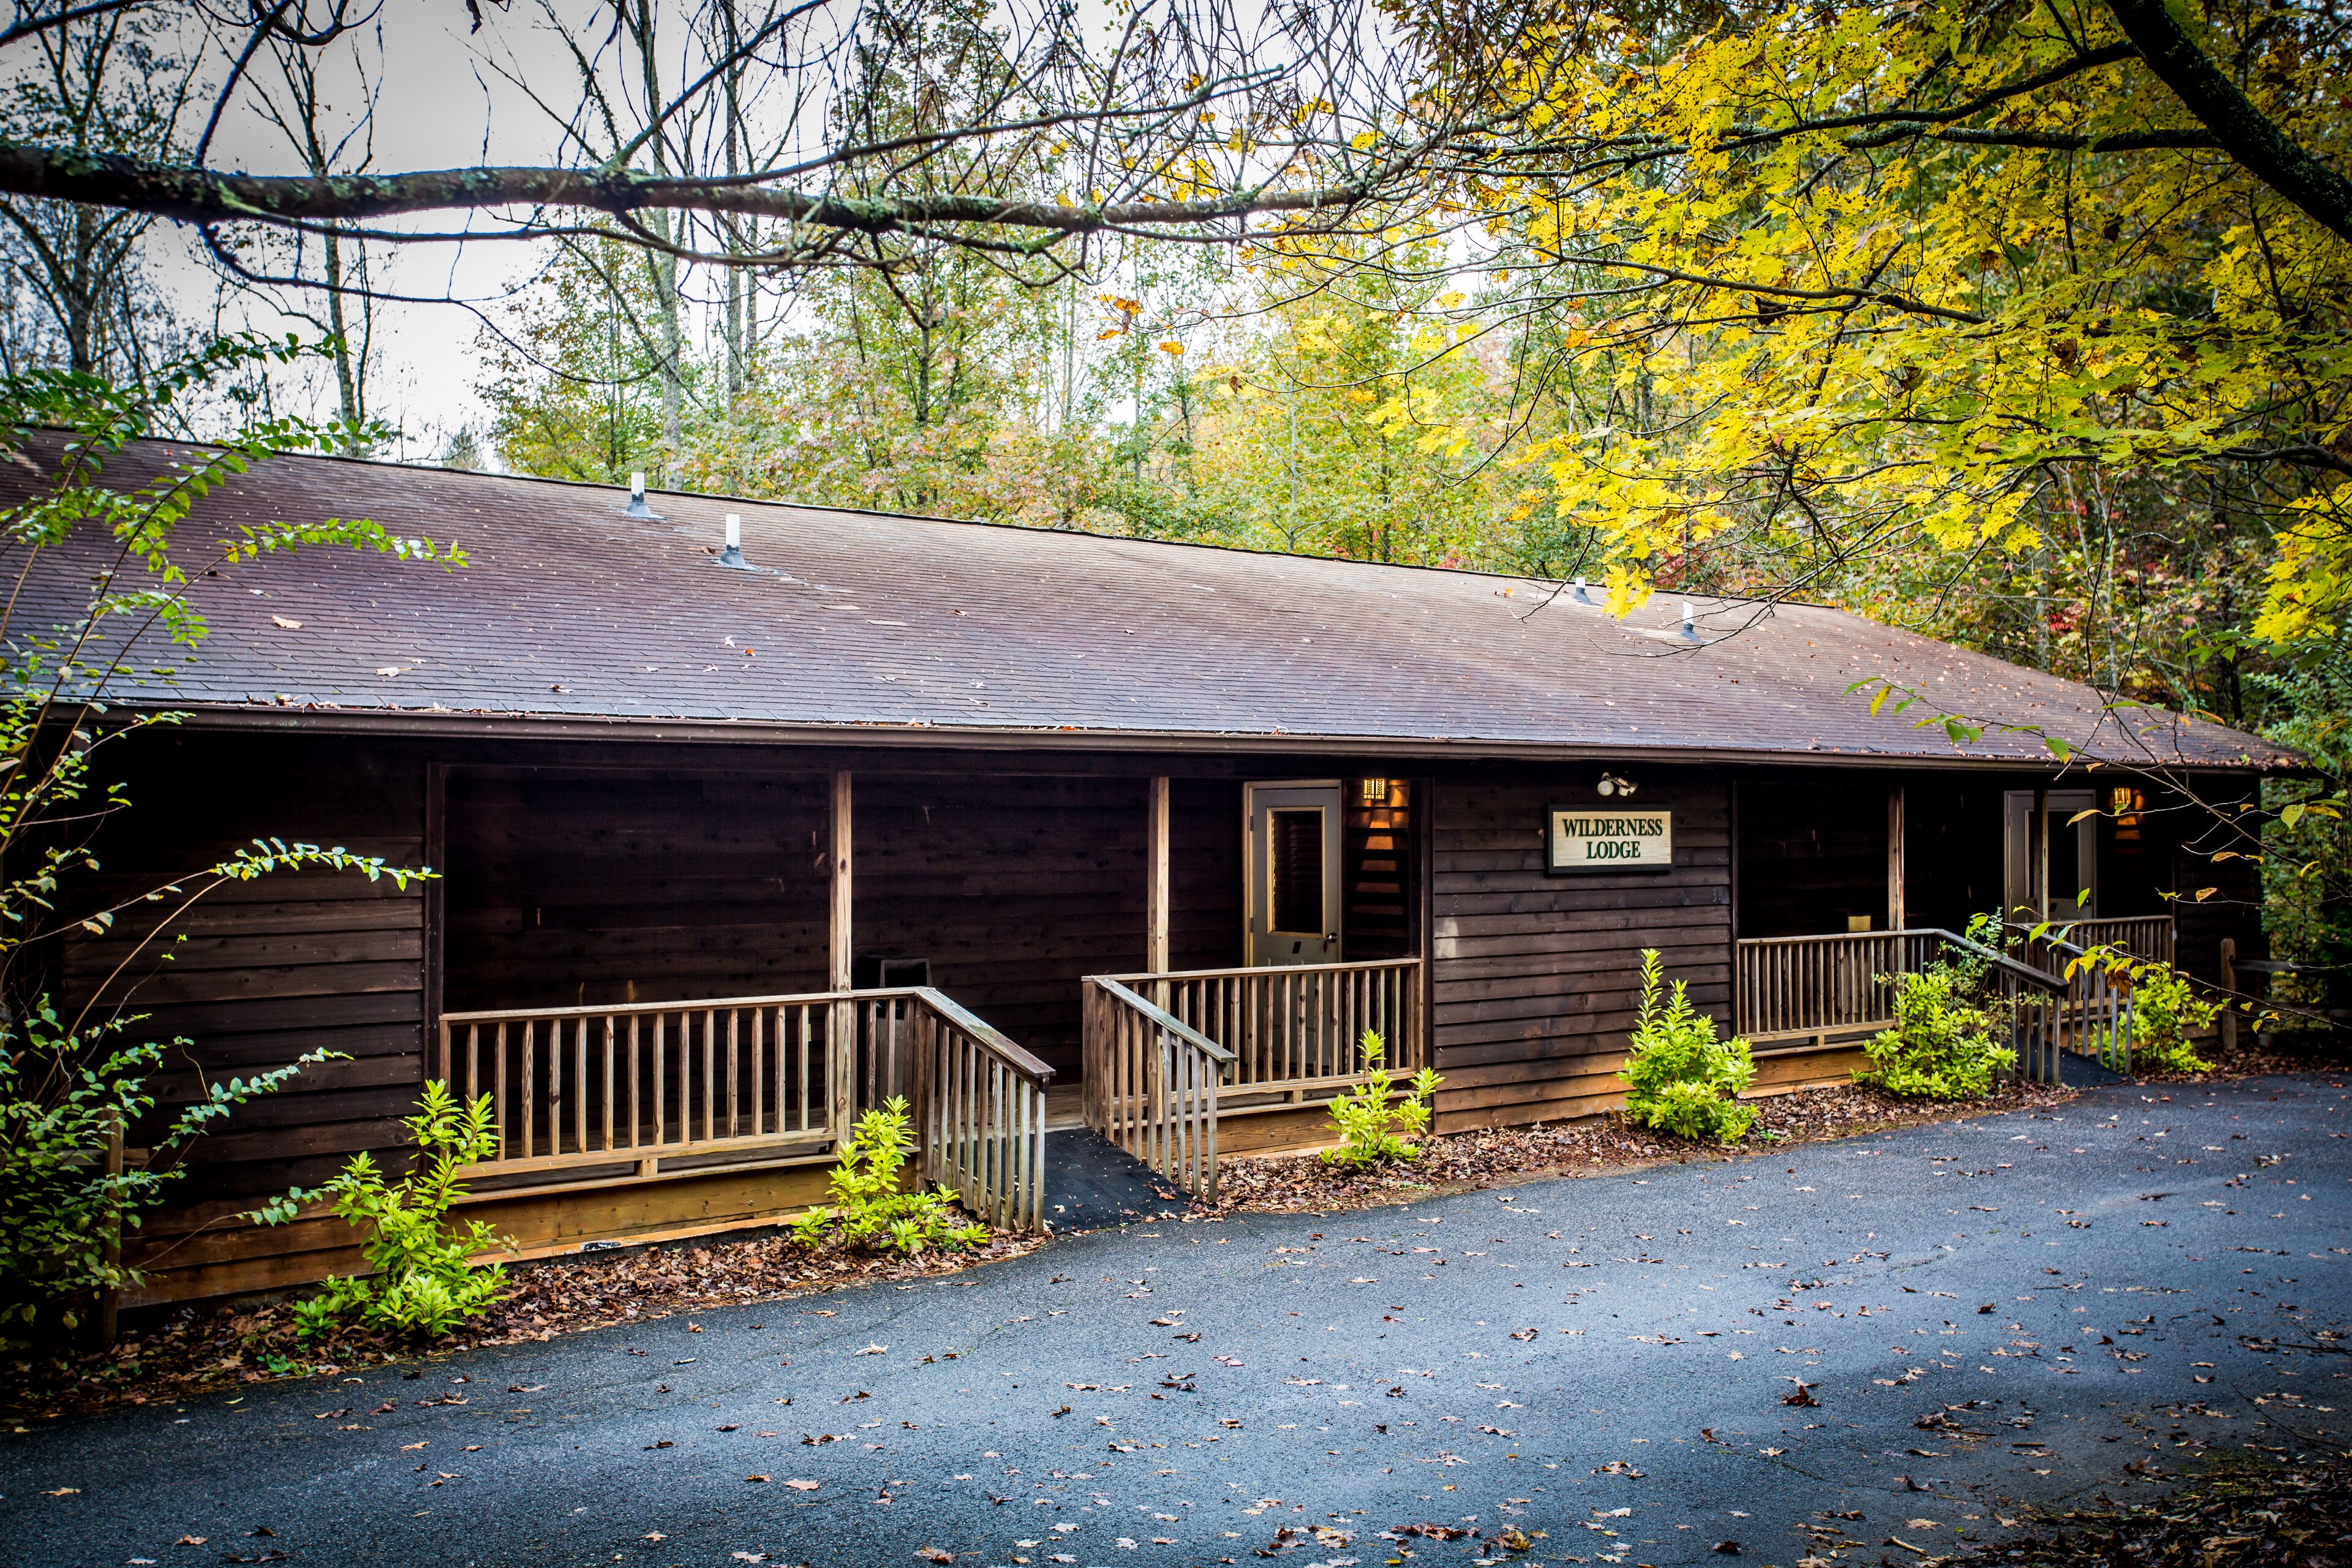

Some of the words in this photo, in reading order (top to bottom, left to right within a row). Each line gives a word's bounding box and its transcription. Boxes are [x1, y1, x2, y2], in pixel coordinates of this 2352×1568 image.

[1562, 818, 1663, 837] WILDERNESS
[1586, 841, 1641, 859] LODGE
[1453, 895, 1459, 909] 2
